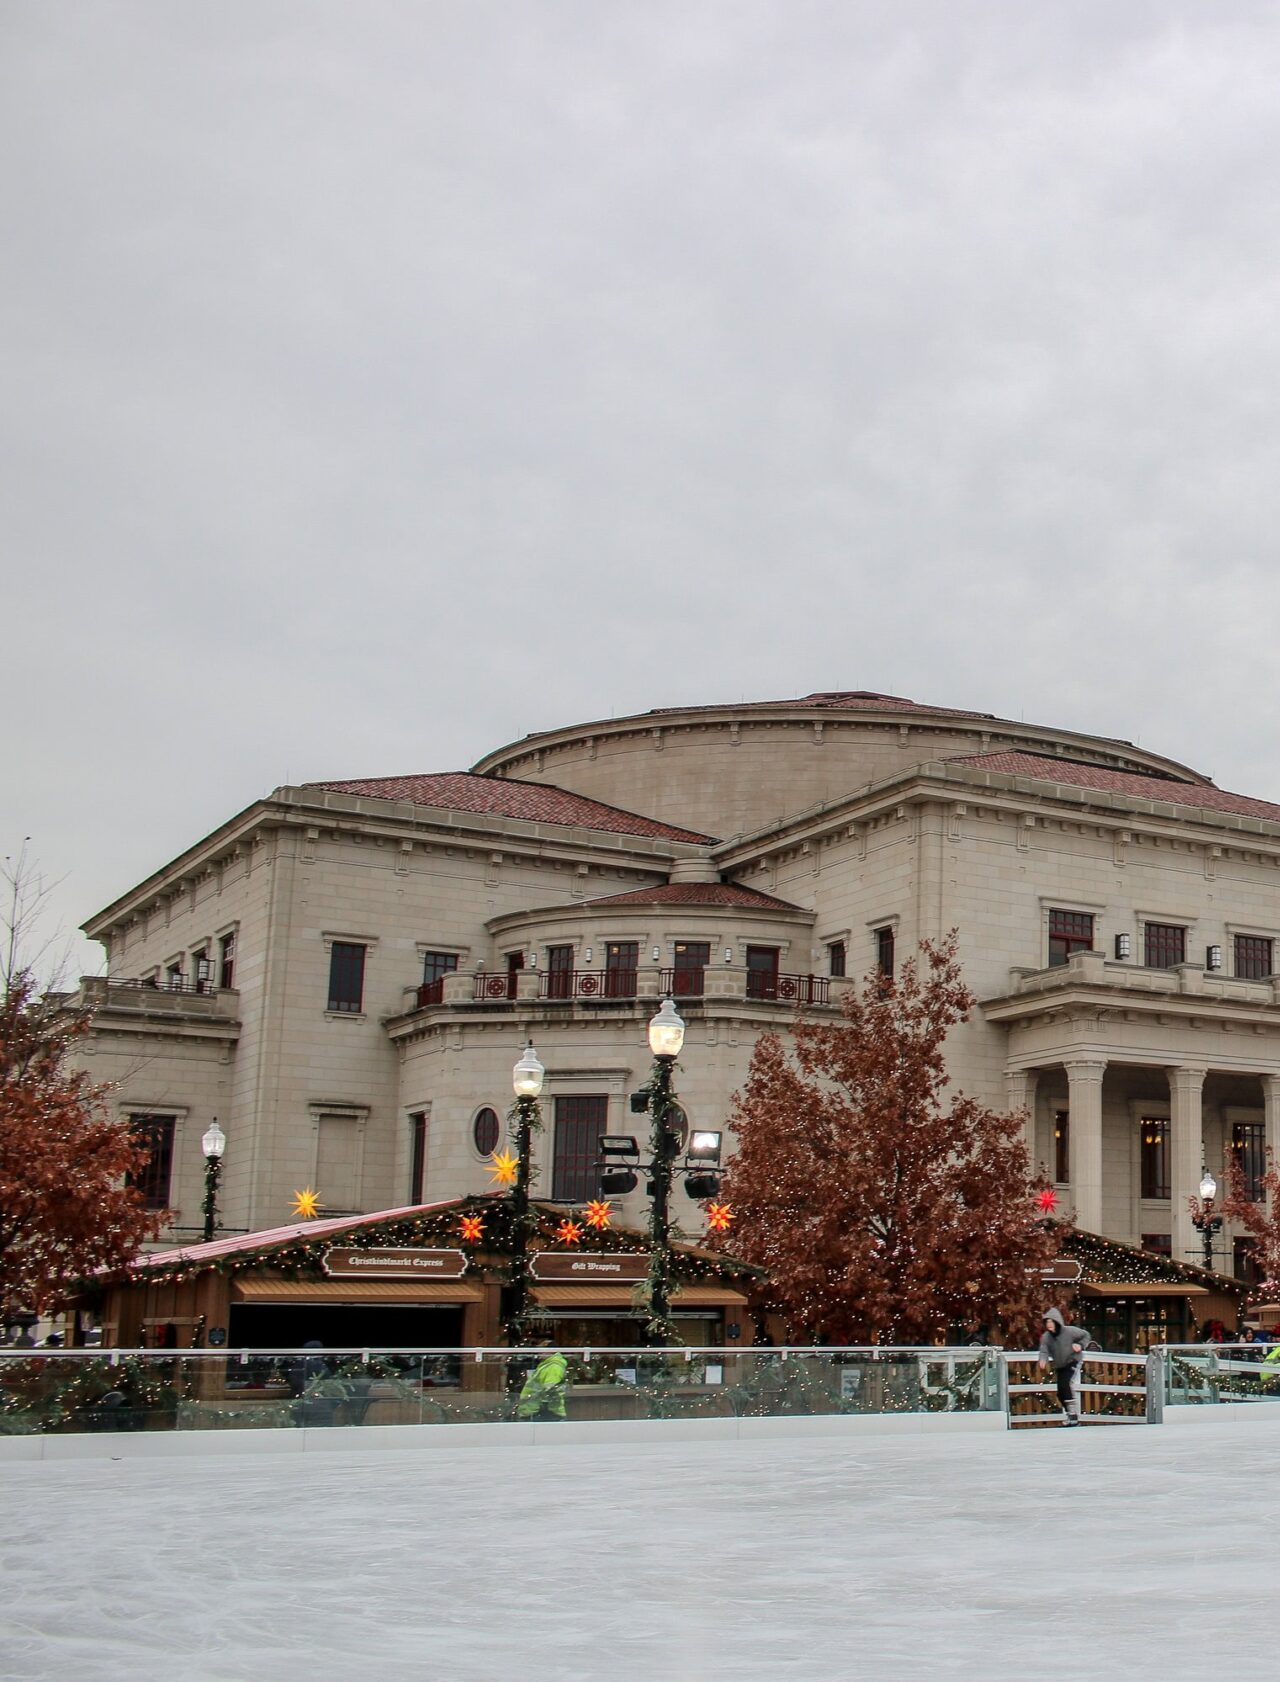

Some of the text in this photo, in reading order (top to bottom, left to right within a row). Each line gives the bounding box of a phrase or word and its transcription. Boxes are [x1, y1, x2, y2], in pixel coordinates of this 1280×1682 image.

[348, 1257, 444, 1267] Christkindlmarkt Express
[571, 1262, 621, 1272] Gift Wrapping
